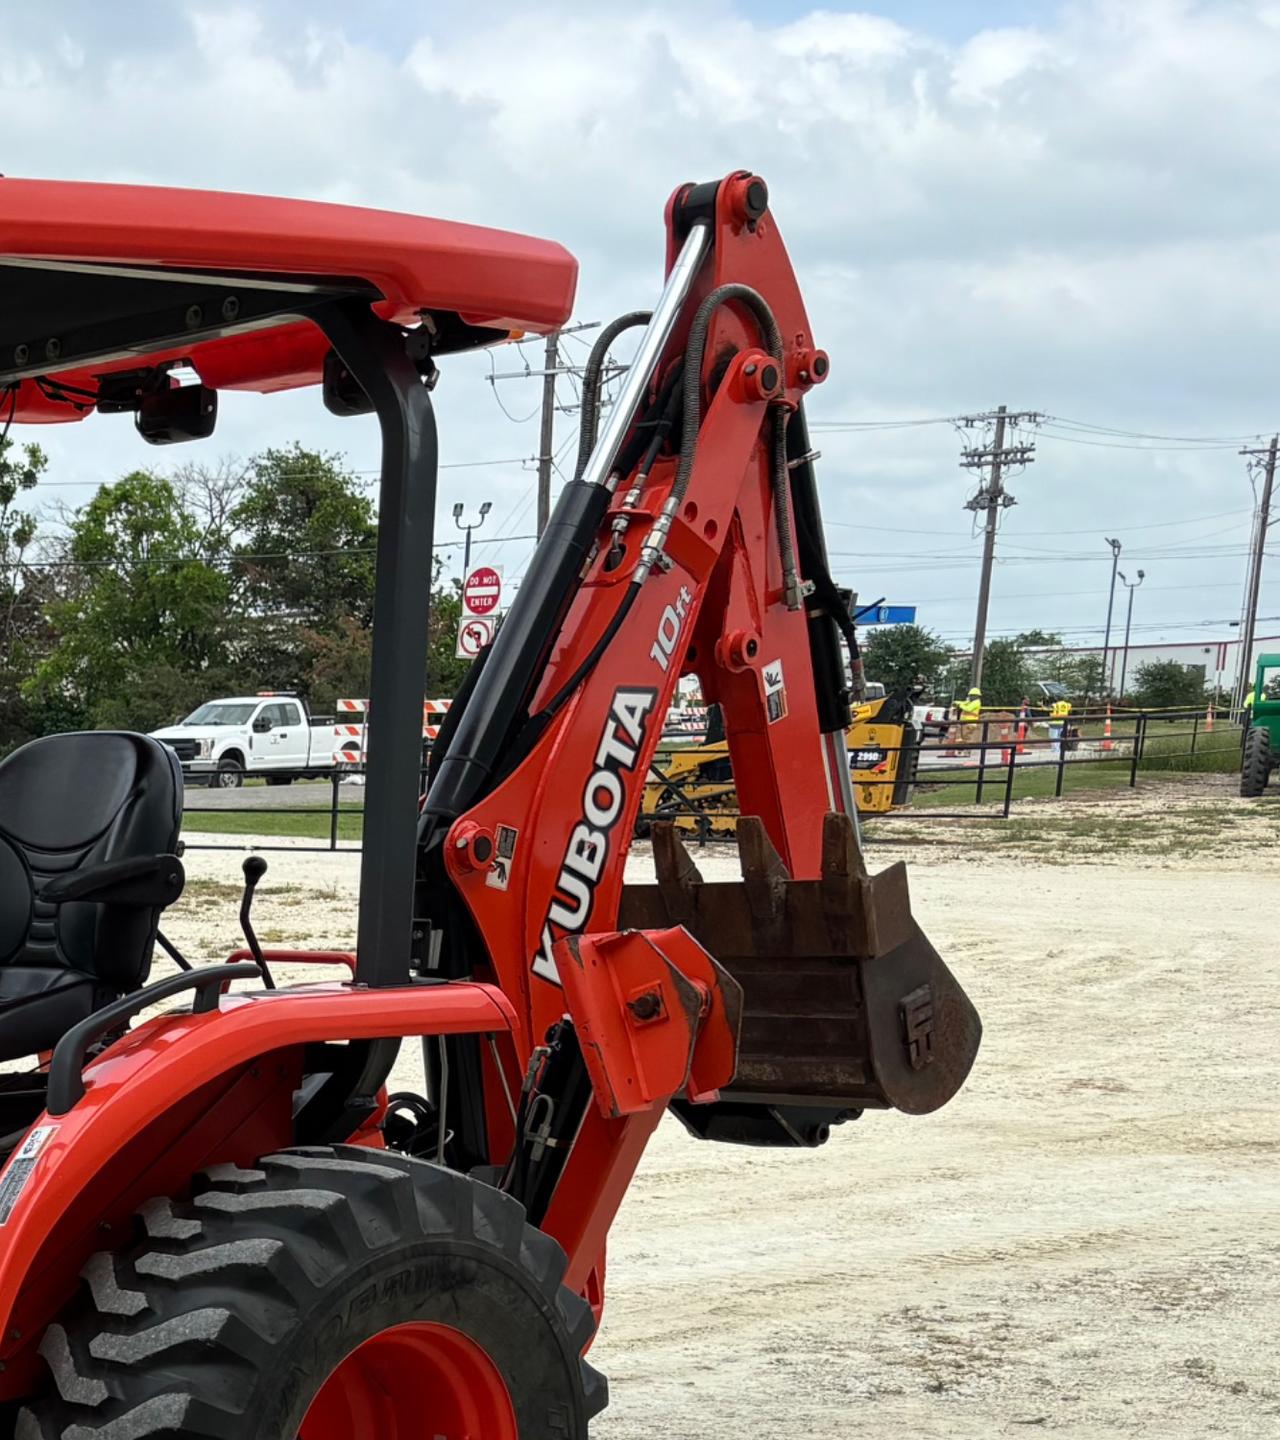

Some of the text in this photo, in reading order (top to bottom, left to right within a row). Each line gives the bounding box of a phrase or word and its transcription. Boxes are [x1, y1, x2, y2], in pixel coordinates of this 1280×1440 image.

[469, 575, 497, 586] DO NOT
[470, 597, 493, 607] ENTER
